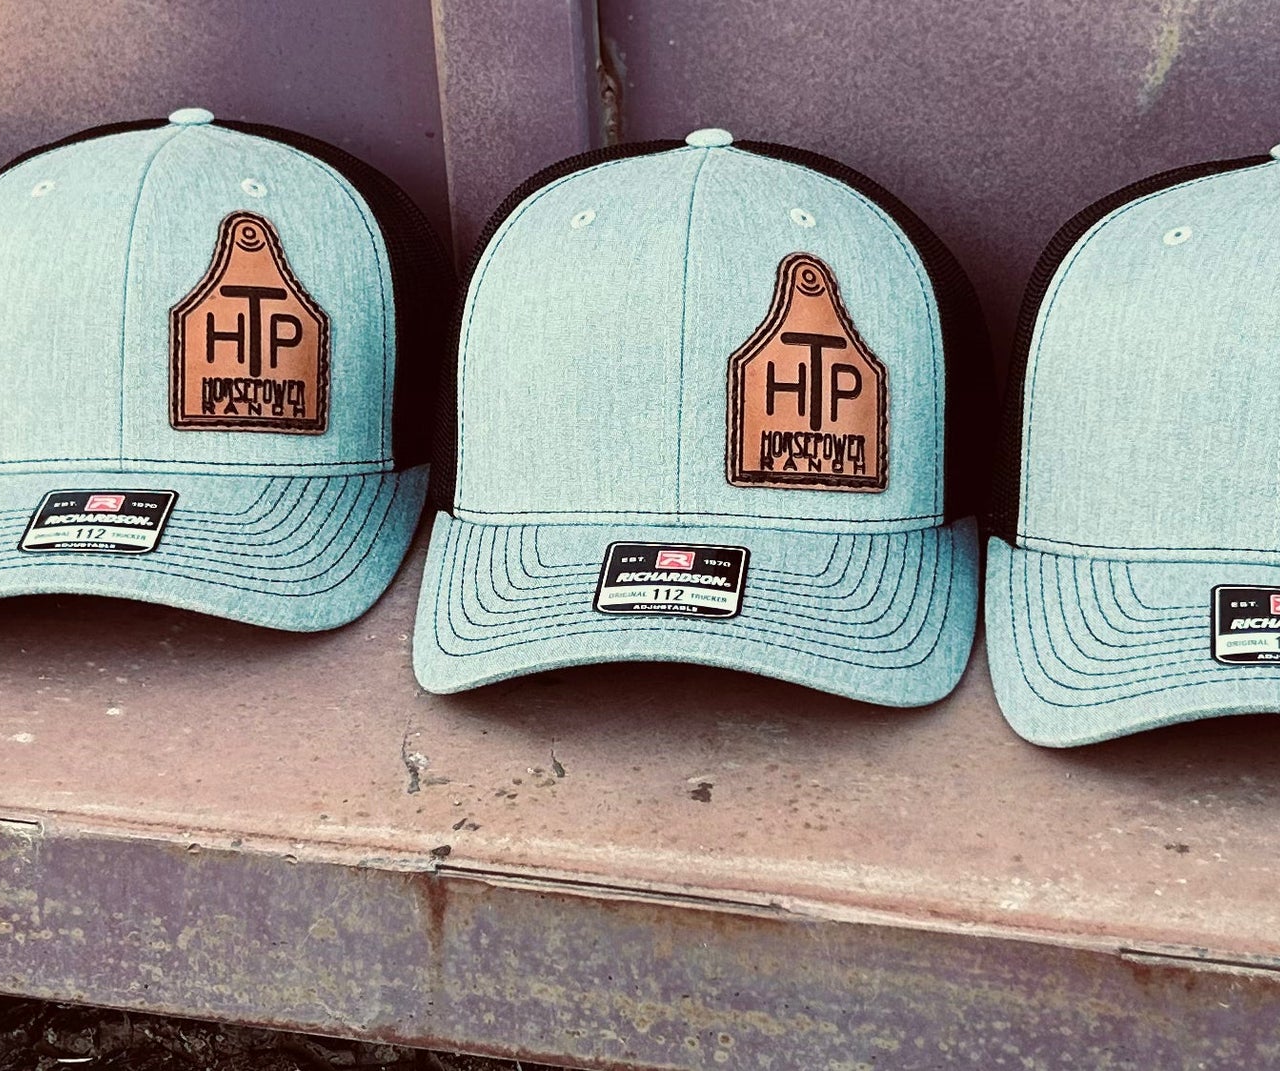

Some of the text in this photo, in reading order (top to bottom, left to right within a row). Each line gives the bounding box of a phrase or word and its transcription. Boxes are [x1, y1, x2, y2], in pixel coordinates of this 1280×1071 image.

[76, 528, 106, 539] 112
[703, 559, 731, 567] 1970
[653, 588, 685, 601] 112
[691, 593, 727, 603] TRUCKER
